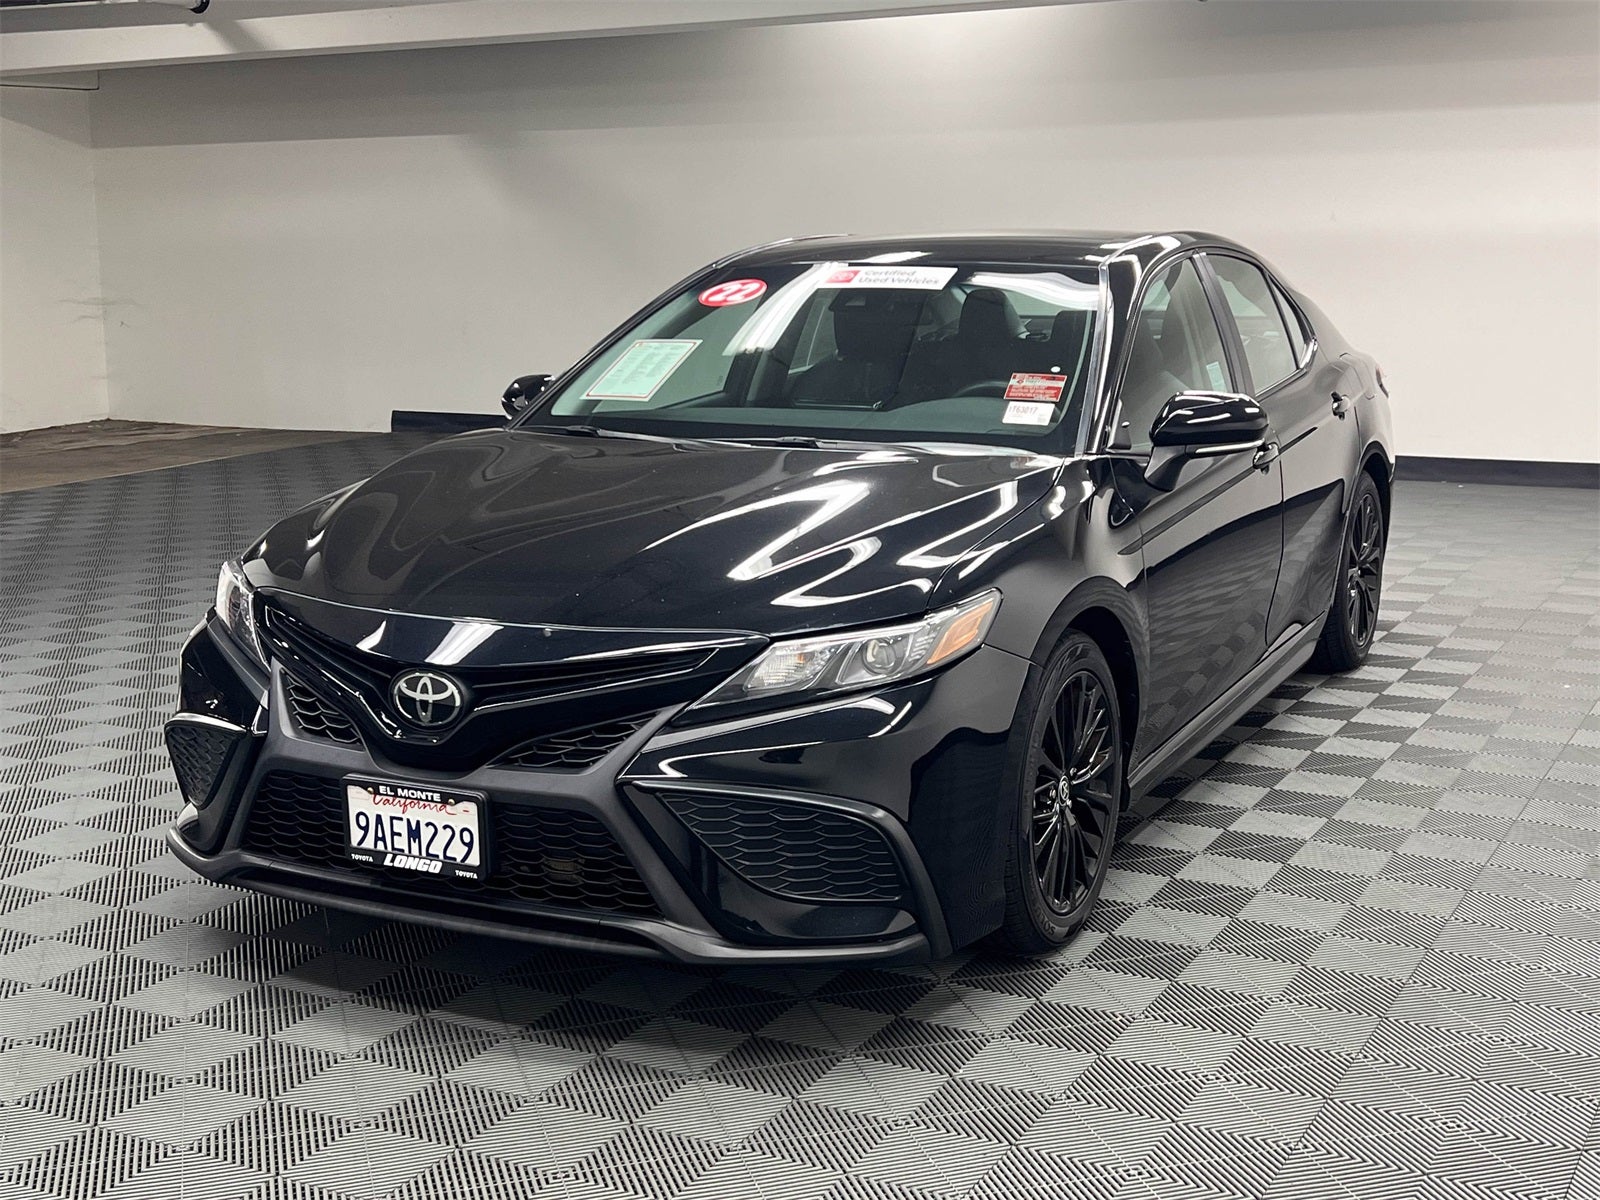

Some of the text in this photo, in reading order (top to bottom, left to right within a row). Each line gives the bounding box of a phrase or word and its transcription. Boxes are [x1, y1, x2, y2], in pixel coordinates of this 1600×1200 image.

[890, 277, 940, 285] Vehicles
[379, 785, 441, 802] EL MONTE
[372, 794, 457, 815] California
[355, 811, 474, 863] 9AEM229
[351, 854, 374, 862] TOYOTA
[383, 854, 443, 873] LONGO
[455, 870, 478, 879] TOYOTA
